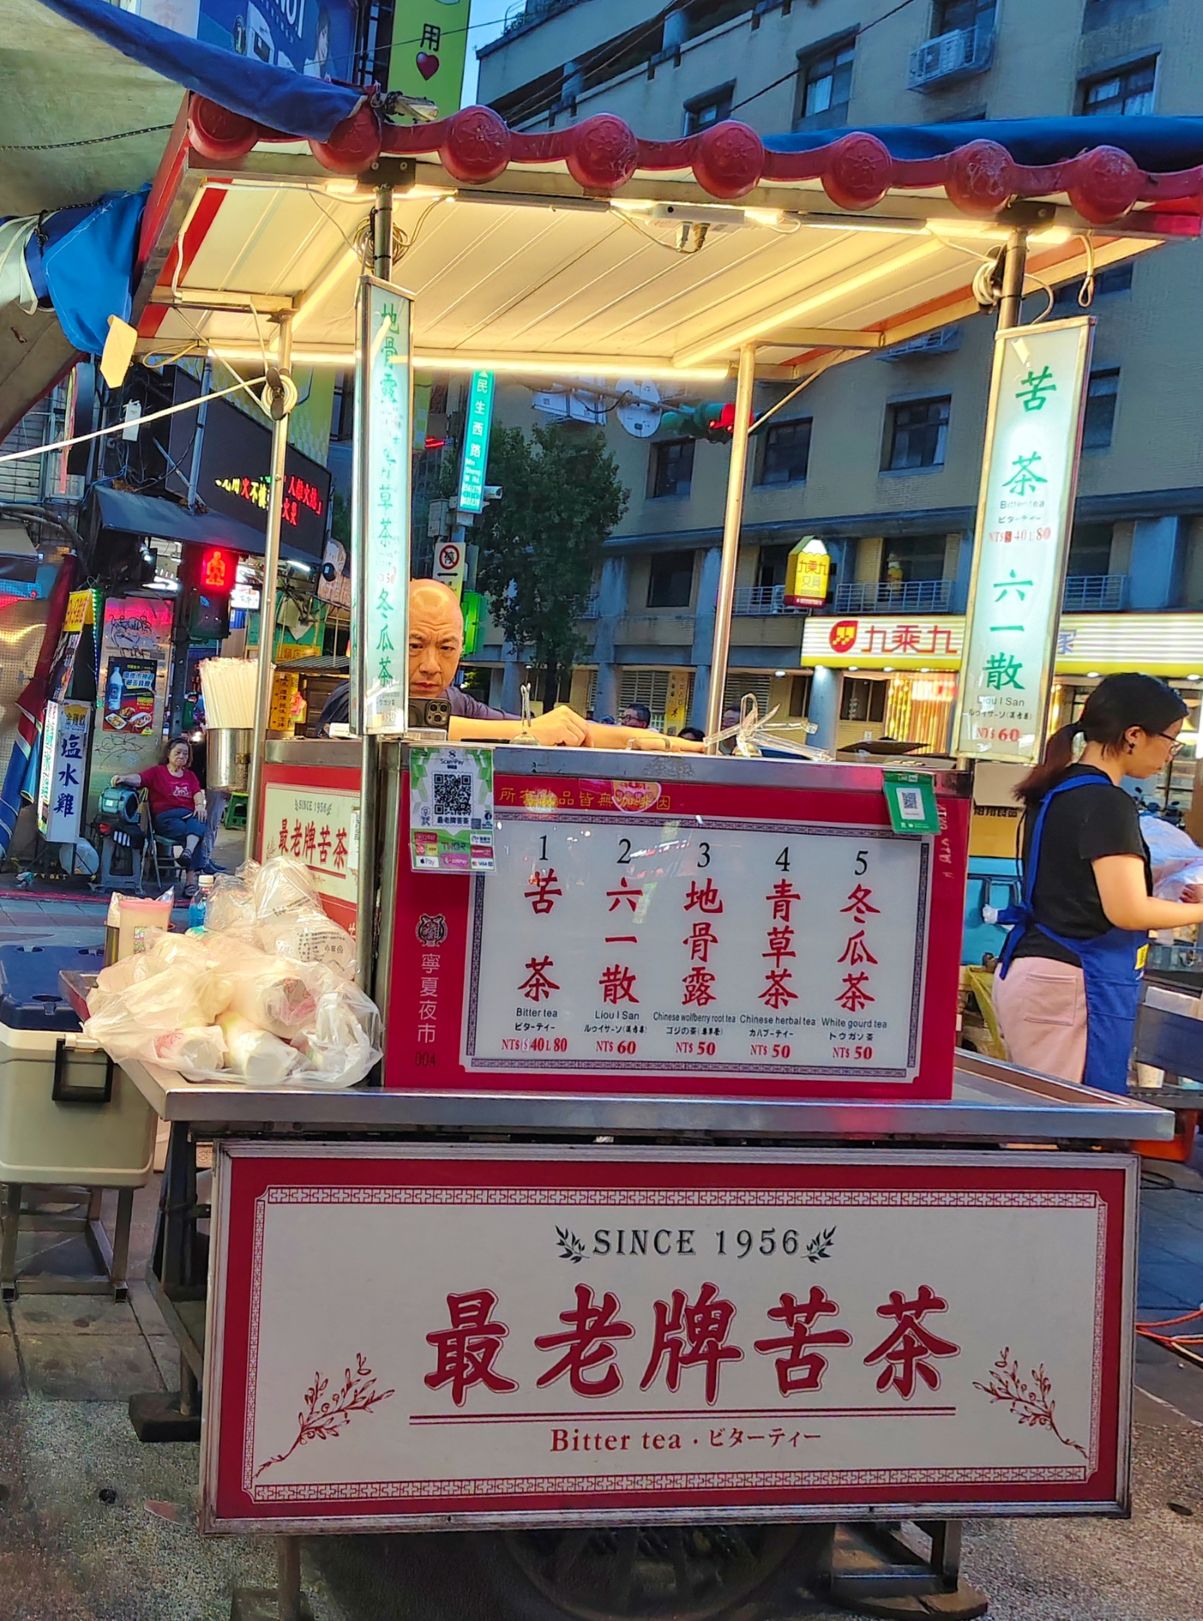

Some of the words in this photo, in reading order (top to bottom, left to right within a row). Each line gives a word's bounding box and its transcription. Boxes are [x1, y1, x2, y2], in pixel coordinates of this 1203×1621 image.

[420, 24, 440, 51] 用
[470, 379, 488, 458] 民生西路
[1002, 366, 1057, 496] 苦茶
[376, 588, 394, 687] 冬瓜茶
[861, 624, 958, 653] 九乘九
[983, 569, 1034, 690] 六一散
[1005, 697, 1025, 707] San
[998, 728, 1020, 742] 60
[53, 735, 83, 818] 塩水雞
[278, 818, 348, 868] 最老牌苦茶
[539, 835, 549, 861] 1
[616, 838, 632, 863] 2
[697, 842, 711, 868] 3
[775, 847, 791, 872] 4
[855, 851, 869, 876] 5
[517, 868, 562, 1002] 苦茶
[599, 877, 643, 1005] 六一散
[681, 878, 724, 1007] 地骨露
[758, 878, 801, 1009] 青草茶
[834, 882, 881, 1012] 冬瓜茶
[417, 953, 440, 1044] 寧夏夜市
[516, 1008, 541, 1017] Bitter
[544, 1009, 557, 1017] tea
[595, 1010, 614, 1019] Liou
[622, 1010, 640, 1020] San
[653, 1011, 679, 1021] Chinese
[726, 1015, 736, 1023] tea
[740, 1014, 773, 1024] Chinese
[776, 1016, 802, 1025] herbal
[803, 1017, 816, 1026] tea
[821, 1017, 846, 1027] White
[848, 1020, 872, 1029] gourd
[874, 1020, 887, 1028] tea
[502, 1039, 520, 1050] NT$
[530, 1037, 545, 1051] 40
[554, 1038, 567, 1052] 80
[596, 1041, 614, 1052] NT$
[617, 1040, 636, 1054] 60
[676, 1042, 693, 1053] NT$
[697, 1042, 716, 1055] 50
[750, 1044, 767, 1055] NT$
[772, 1044, 791, 1058] 50
[833, 1047, 849, 1058] NT$
[854, 1046, 872, 1060] 50
[593, 1228, 696, 1256] SINCE
[716, 1226, 799, 1257] 1956
[423, 1281, 961, 1407] 最老牌苦茶
[550, 1429, 630, 1453] Bitter
[641, 1430, 682, 1451] tea
[709, 1427, 822, 1449] ビターティー
